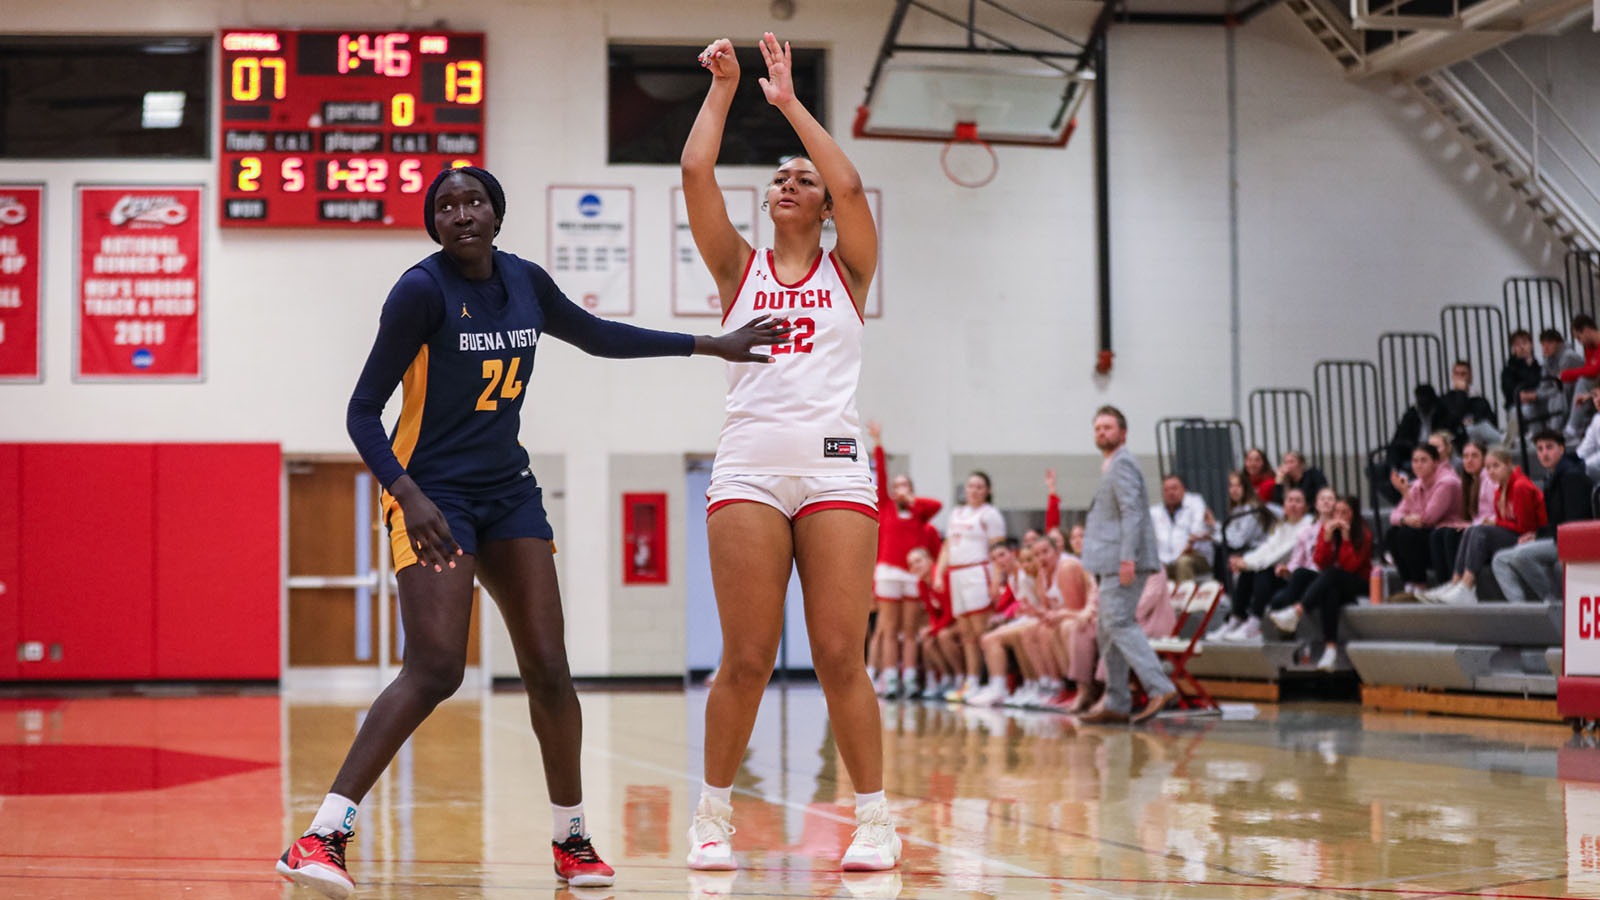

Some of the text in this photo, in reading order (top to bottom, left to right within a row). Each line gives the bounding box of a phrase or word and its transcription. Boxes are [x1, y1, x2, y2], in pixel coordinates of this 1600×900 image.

[338, 33, 412, 77] 1:46
[232, 57, 286, 101] 07
[445, 60, 482, 104] 13
[325, 104, 379, 122] period
[391, 93, 415, 126] 0
[226, 132, 267, 150] fouls
[324, 133, 381, 152] player
[238, 156, 262, 191] 2
[281, 157, 304, 192] 5
[399, 159, 423, 193] 5
[323, 200, 379, 222] weight
[101, 236, 178, 255] NATIONAL
[93, 255, 187, 274] RUNNER-UP
[84, 279, 195, 298] MEN'S INDOOR
[753, 289, 833, 311] DUTCH
[85, 298, 136, 316] TRACK
[152, 298, 195, 316] FIELD
[114, 321, 165, 345] 2011
[459, 328, 538, 351] BUENA VISTA
[475, 357, 522, 411] 24
